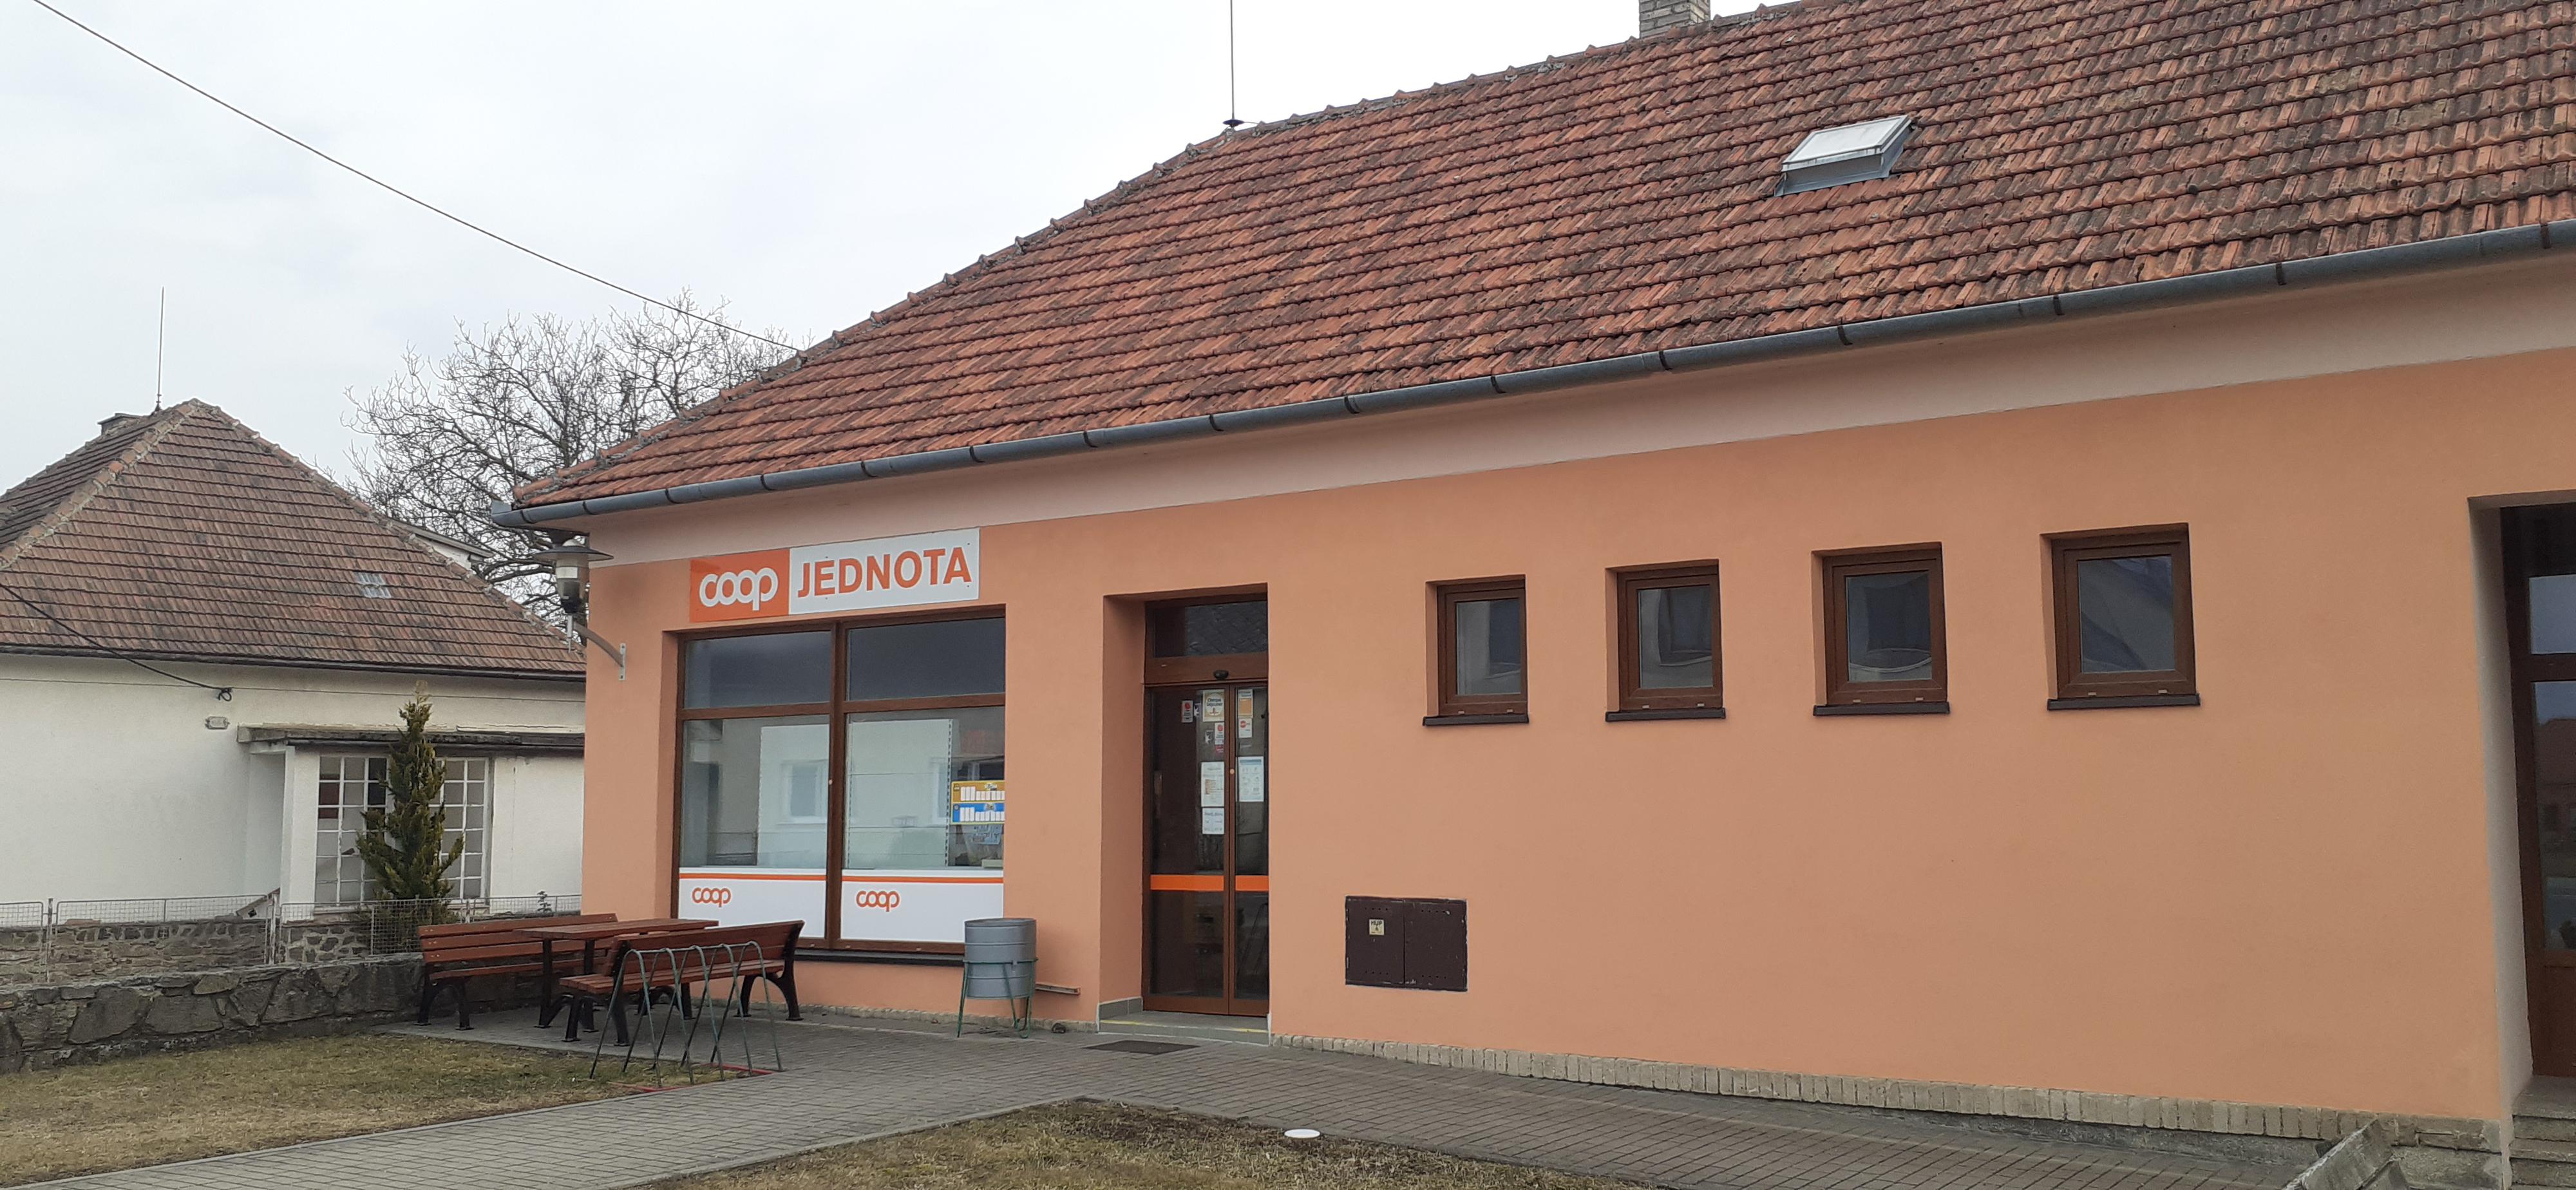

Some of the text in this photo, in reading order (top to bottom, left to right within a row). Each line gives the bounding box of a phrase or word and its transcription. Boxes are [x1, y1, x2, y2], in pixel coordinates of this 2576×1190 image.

[699, 547, 972, 611] coop JEDNOTA
[692, 887, 732, 908] coop
[856, 890, 900, 912] coop
